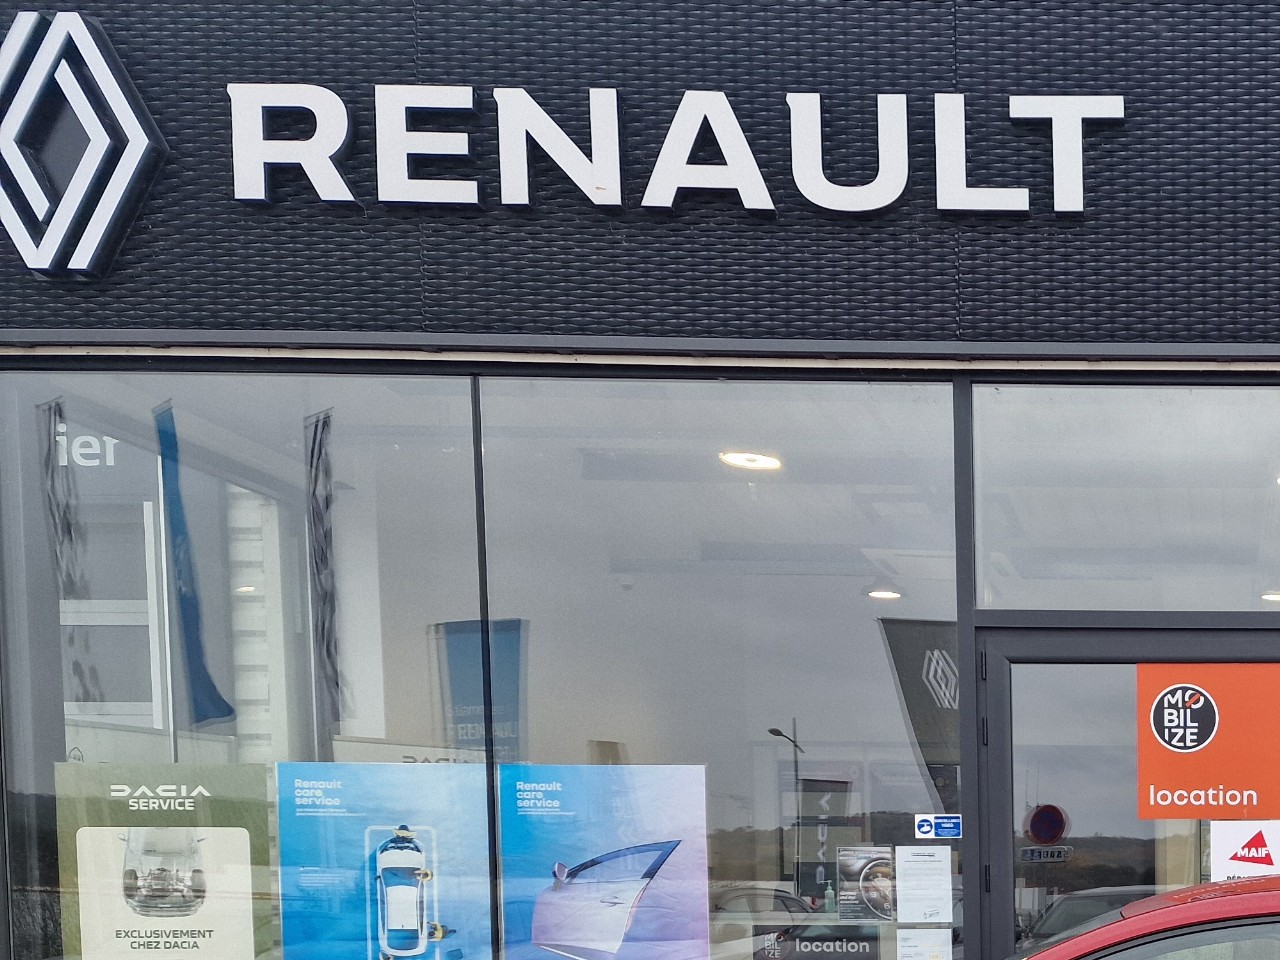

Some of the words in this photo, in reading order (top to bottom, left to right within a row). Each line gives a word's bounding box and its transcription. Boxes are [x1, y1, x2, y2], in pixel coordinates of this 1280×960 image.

[227, 83, 1125, 213] RENAULT
[294, 778, 343, 788] Renault
[516, 781, 562, 791] Renault
[1149, 784, 1258, 806] location
[128, 798, 196, 811] SERVICE
[295, 796, 340, 806] service
[516, 797, 560, 807] service
[1236, 848, 1269, 858] MAIF
[115, 929, 214, 939] EXCLUSIVEMENT
[130, 940, 161, 950] CHEZ
[163, 940, 200, 950] DACIA
[795, 938, 870, 953] location
